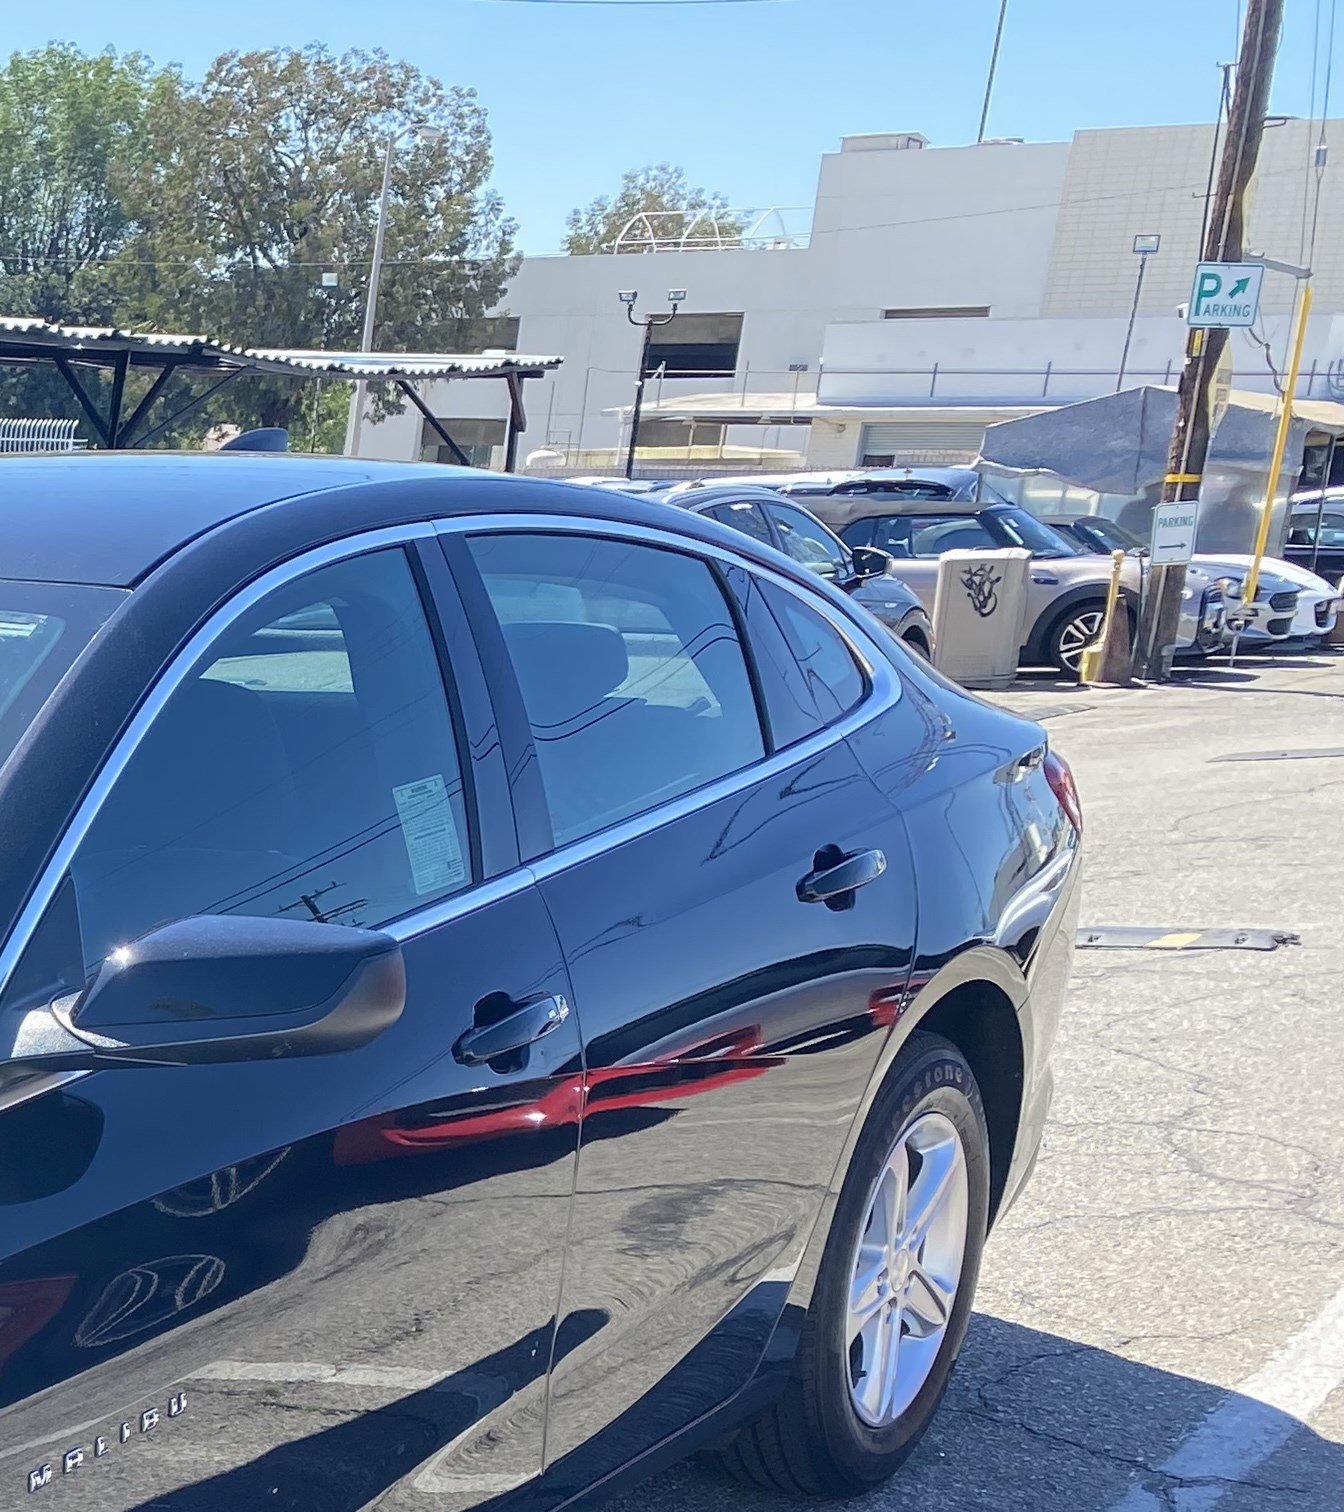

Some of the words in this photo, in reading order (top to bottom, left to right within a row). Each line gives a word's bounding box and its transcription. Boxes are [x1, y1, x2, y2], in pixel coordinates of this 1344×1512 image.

[1194, 273, 1251, 317] PARKING
[1157, 515, 1194, 528] PARKING
[27, 1392, 188, 1494] MALIBU
